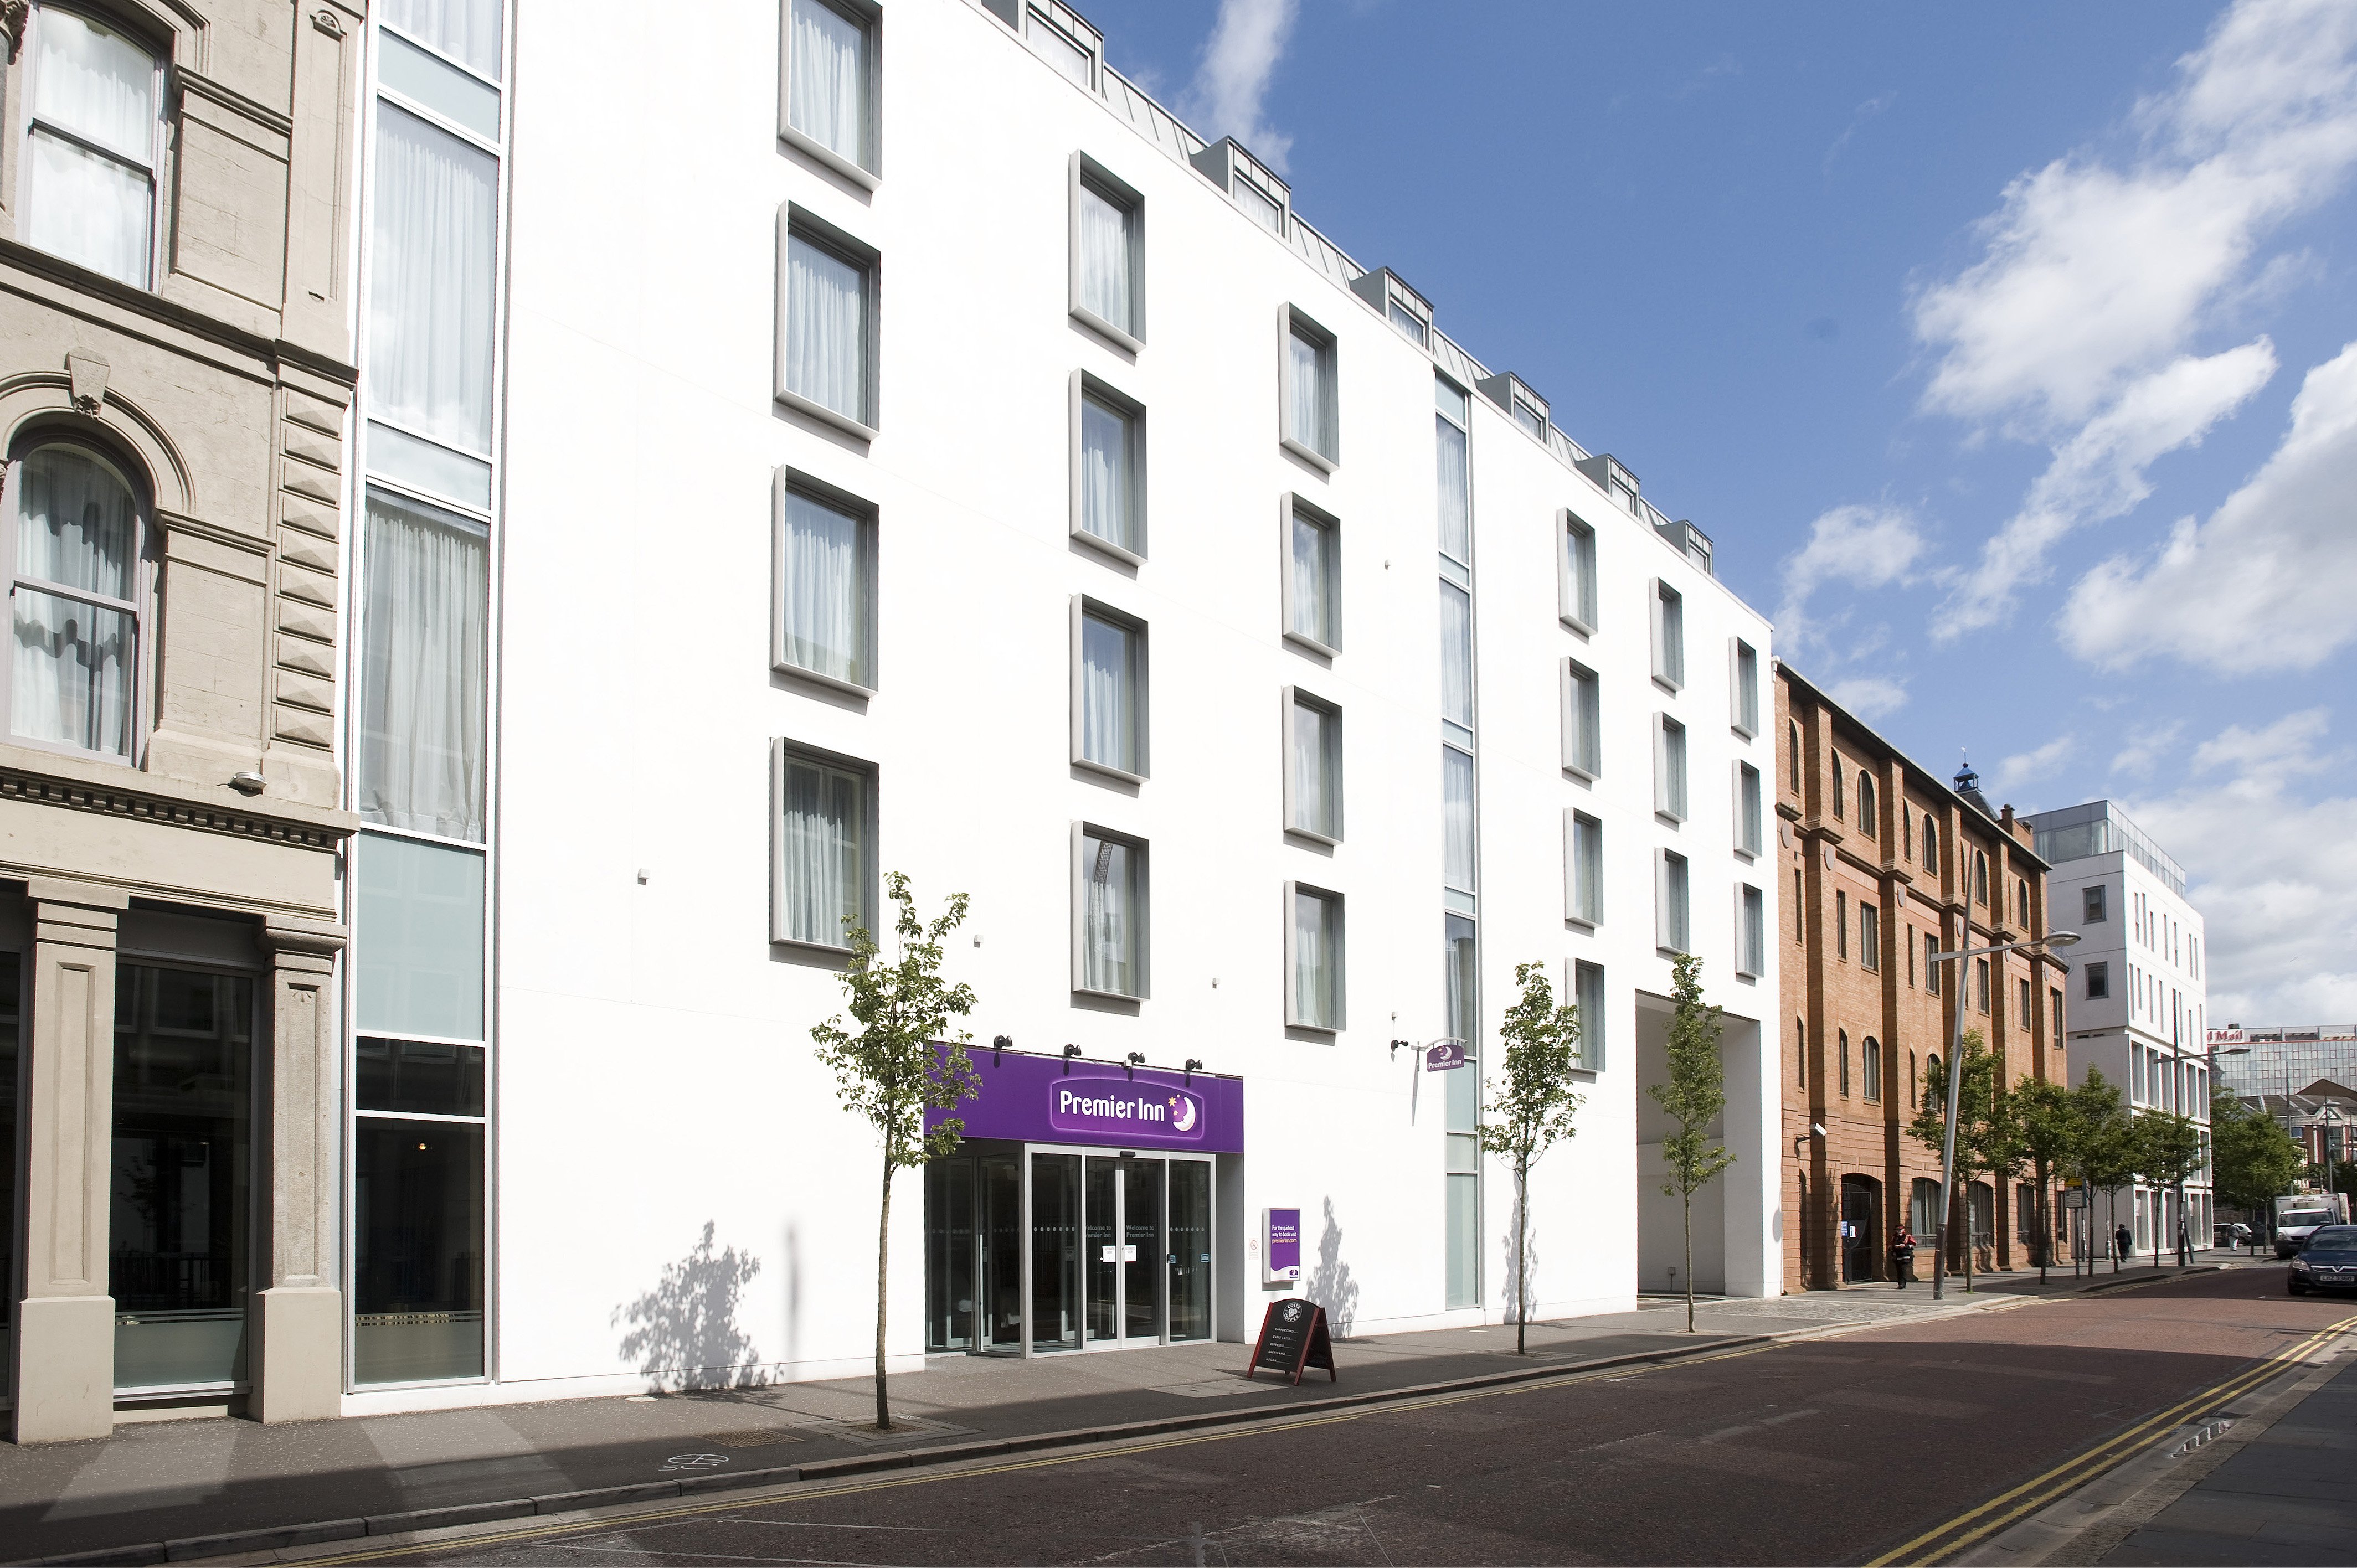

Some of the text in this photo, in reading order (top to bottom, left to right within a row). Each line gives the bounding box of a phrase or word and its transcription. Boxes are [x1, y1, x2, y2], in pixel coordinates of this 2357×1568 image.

[2215, 1030, 2243, 1041] Mail
[1428, 1060, 1451, 1069] Premier
[1060, 1090, 1165, 1122] Premier Inn
[1284, 1313, 1299, 1322] COFFEE
